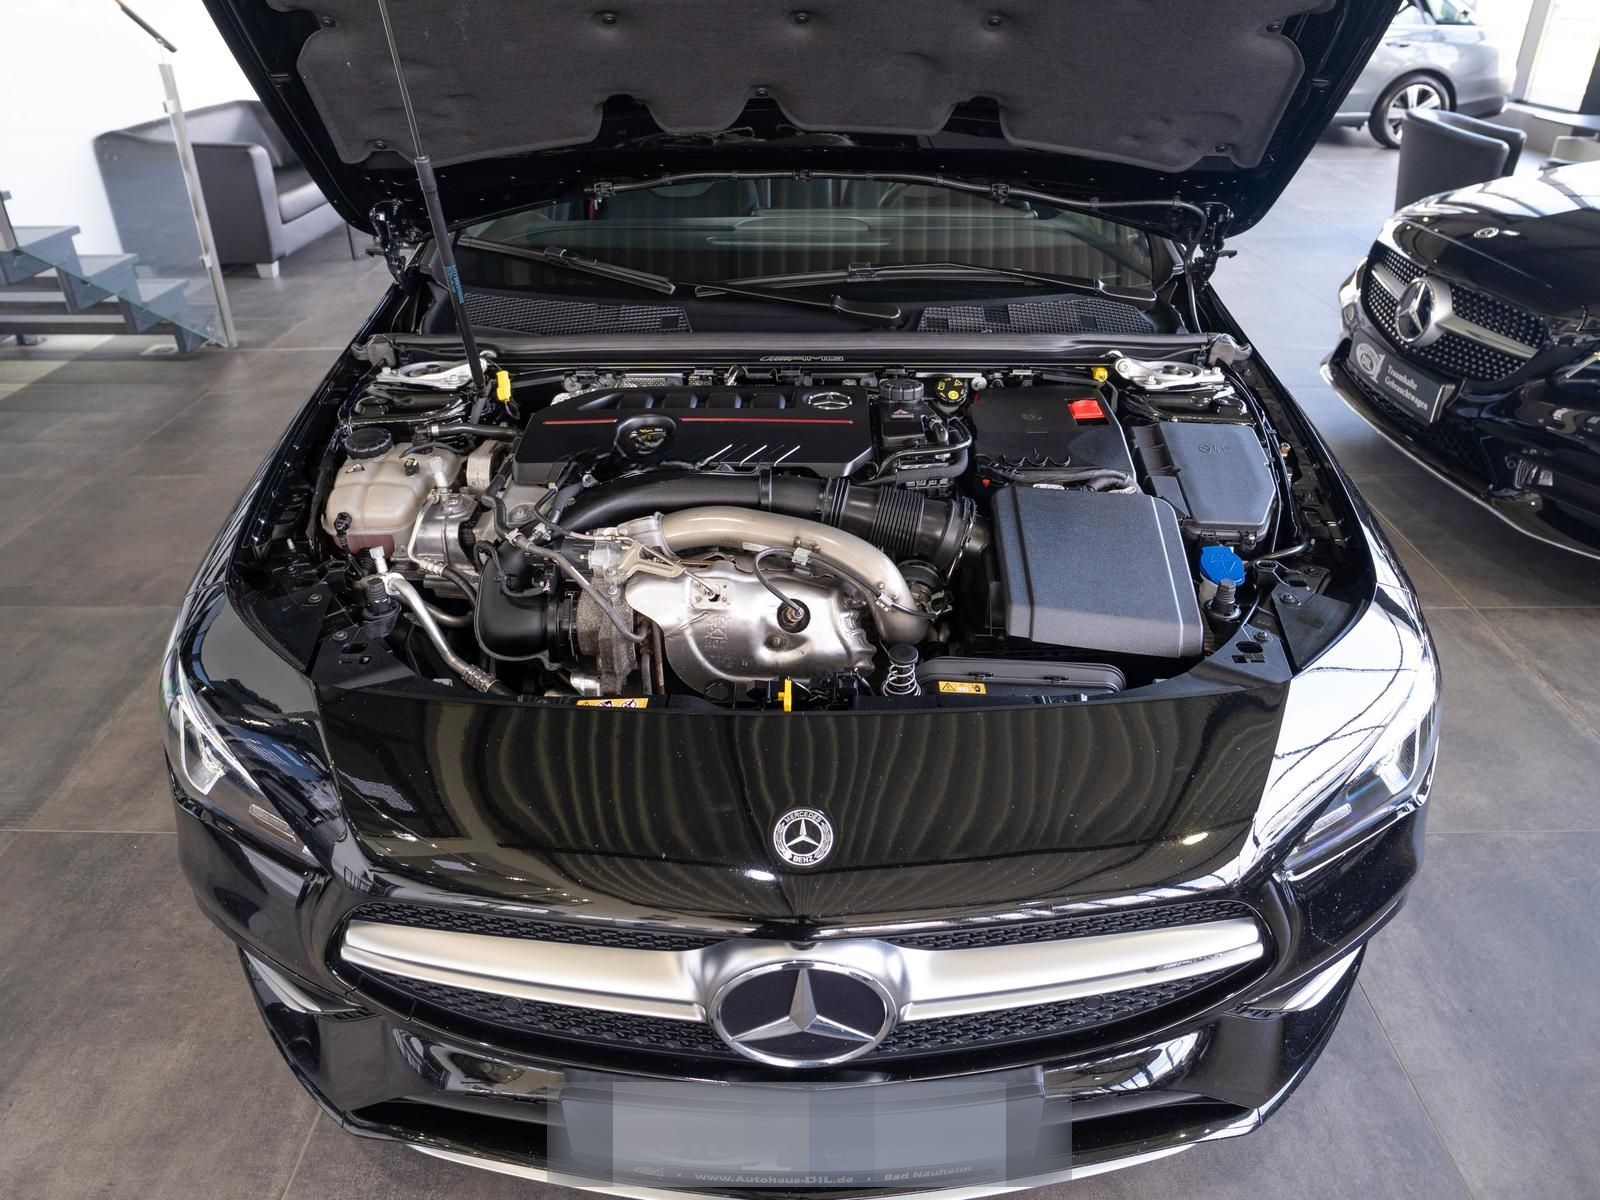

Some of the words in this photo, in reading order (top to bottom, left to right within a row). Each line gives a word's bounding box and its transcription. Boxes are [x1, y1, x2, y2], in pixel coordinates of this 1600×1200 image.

[1361, 353, 1372, 371] DIL
[1387, 365, 1417, 390] Traumhafte
[1385, 376, 1427, 410] Gebrauchtwagen
[784, 811, 822, 823] MERCEDES
[793, 855, 814, 863] BENZ
[884, 1172, 910, 1181] Bad
